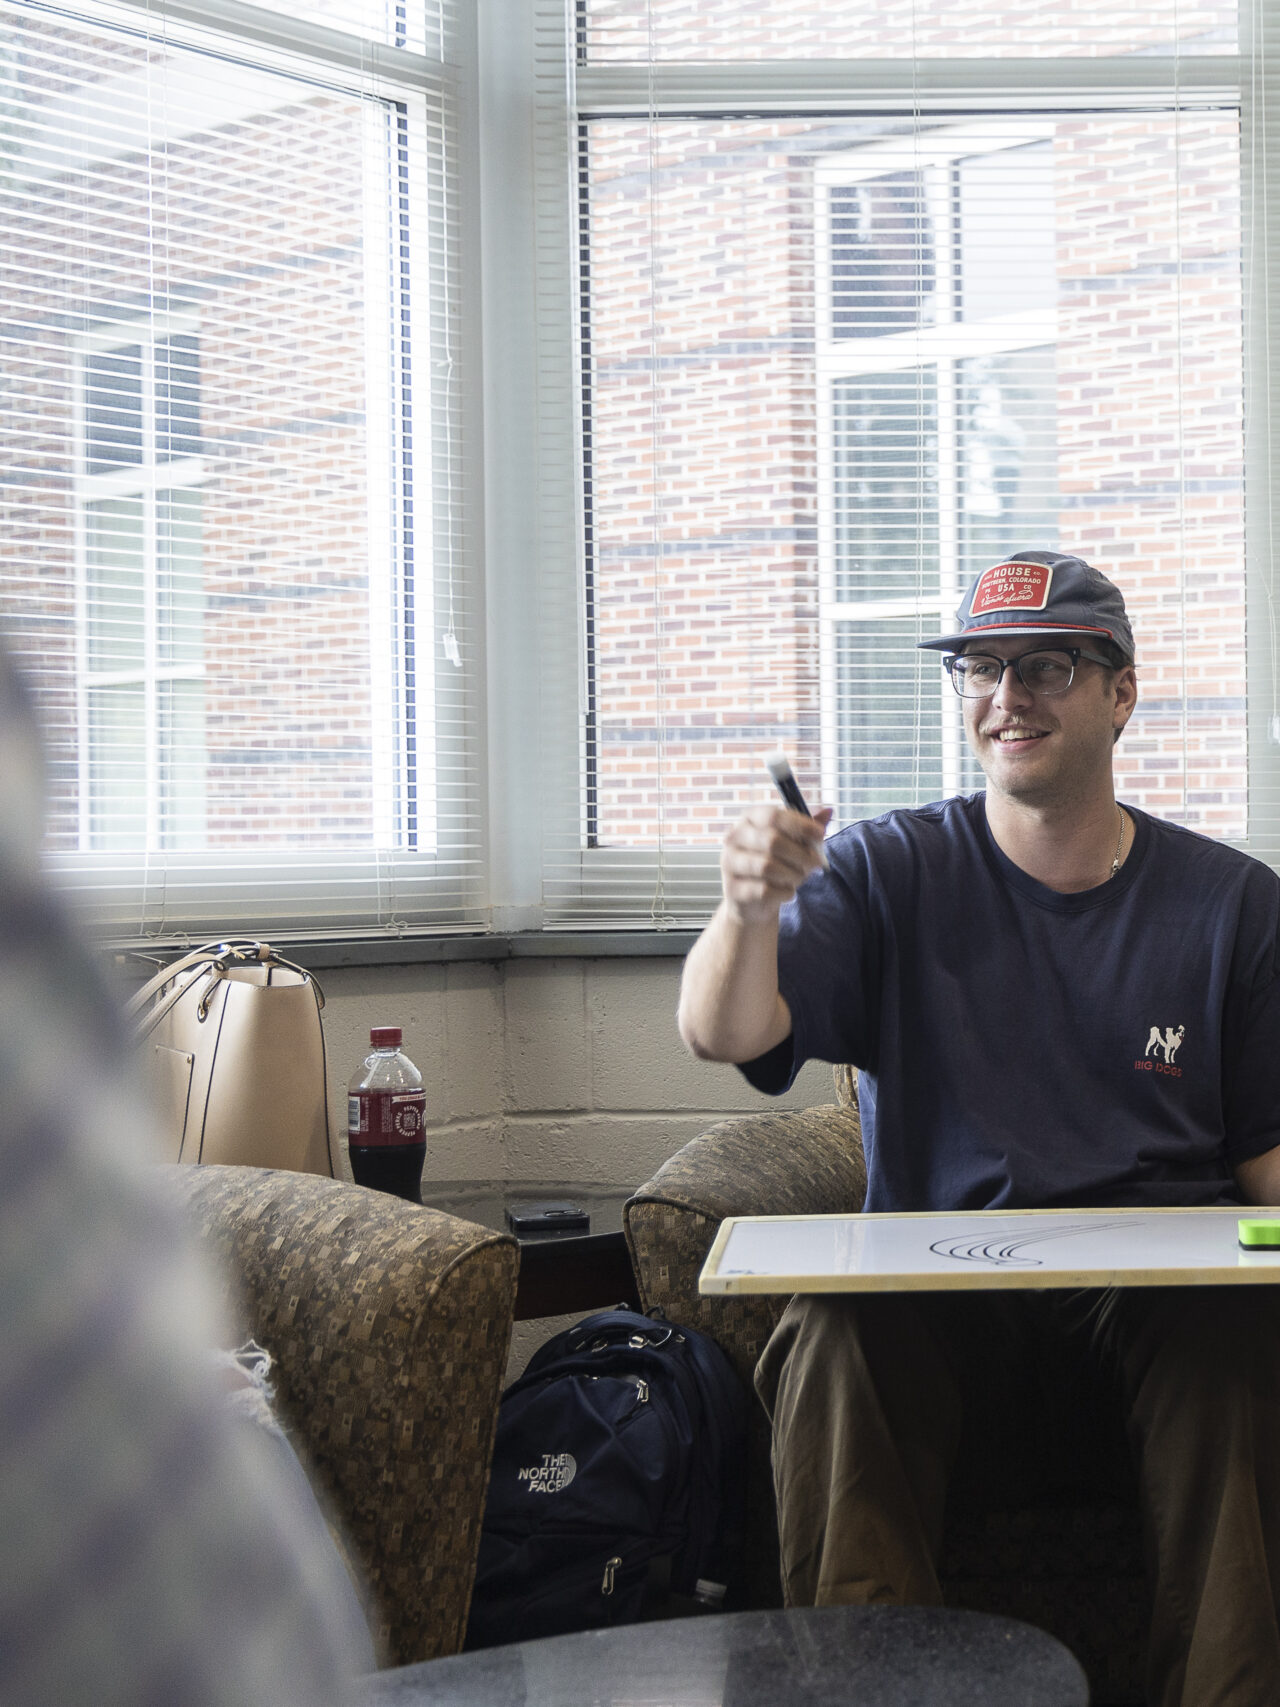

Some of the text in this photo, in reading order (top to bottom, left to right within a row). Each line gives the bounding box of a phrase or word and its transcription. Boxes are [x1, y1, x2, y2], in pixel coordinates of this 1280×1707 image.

[994, 567, 1031, 578] HOUSE
[998, 583, 1014, 592] USA
[541, 1453, 566, 1467] THE
[517, 1466, 565, 1480] NORTH
[528, 1480, 563, 1493] FACE
